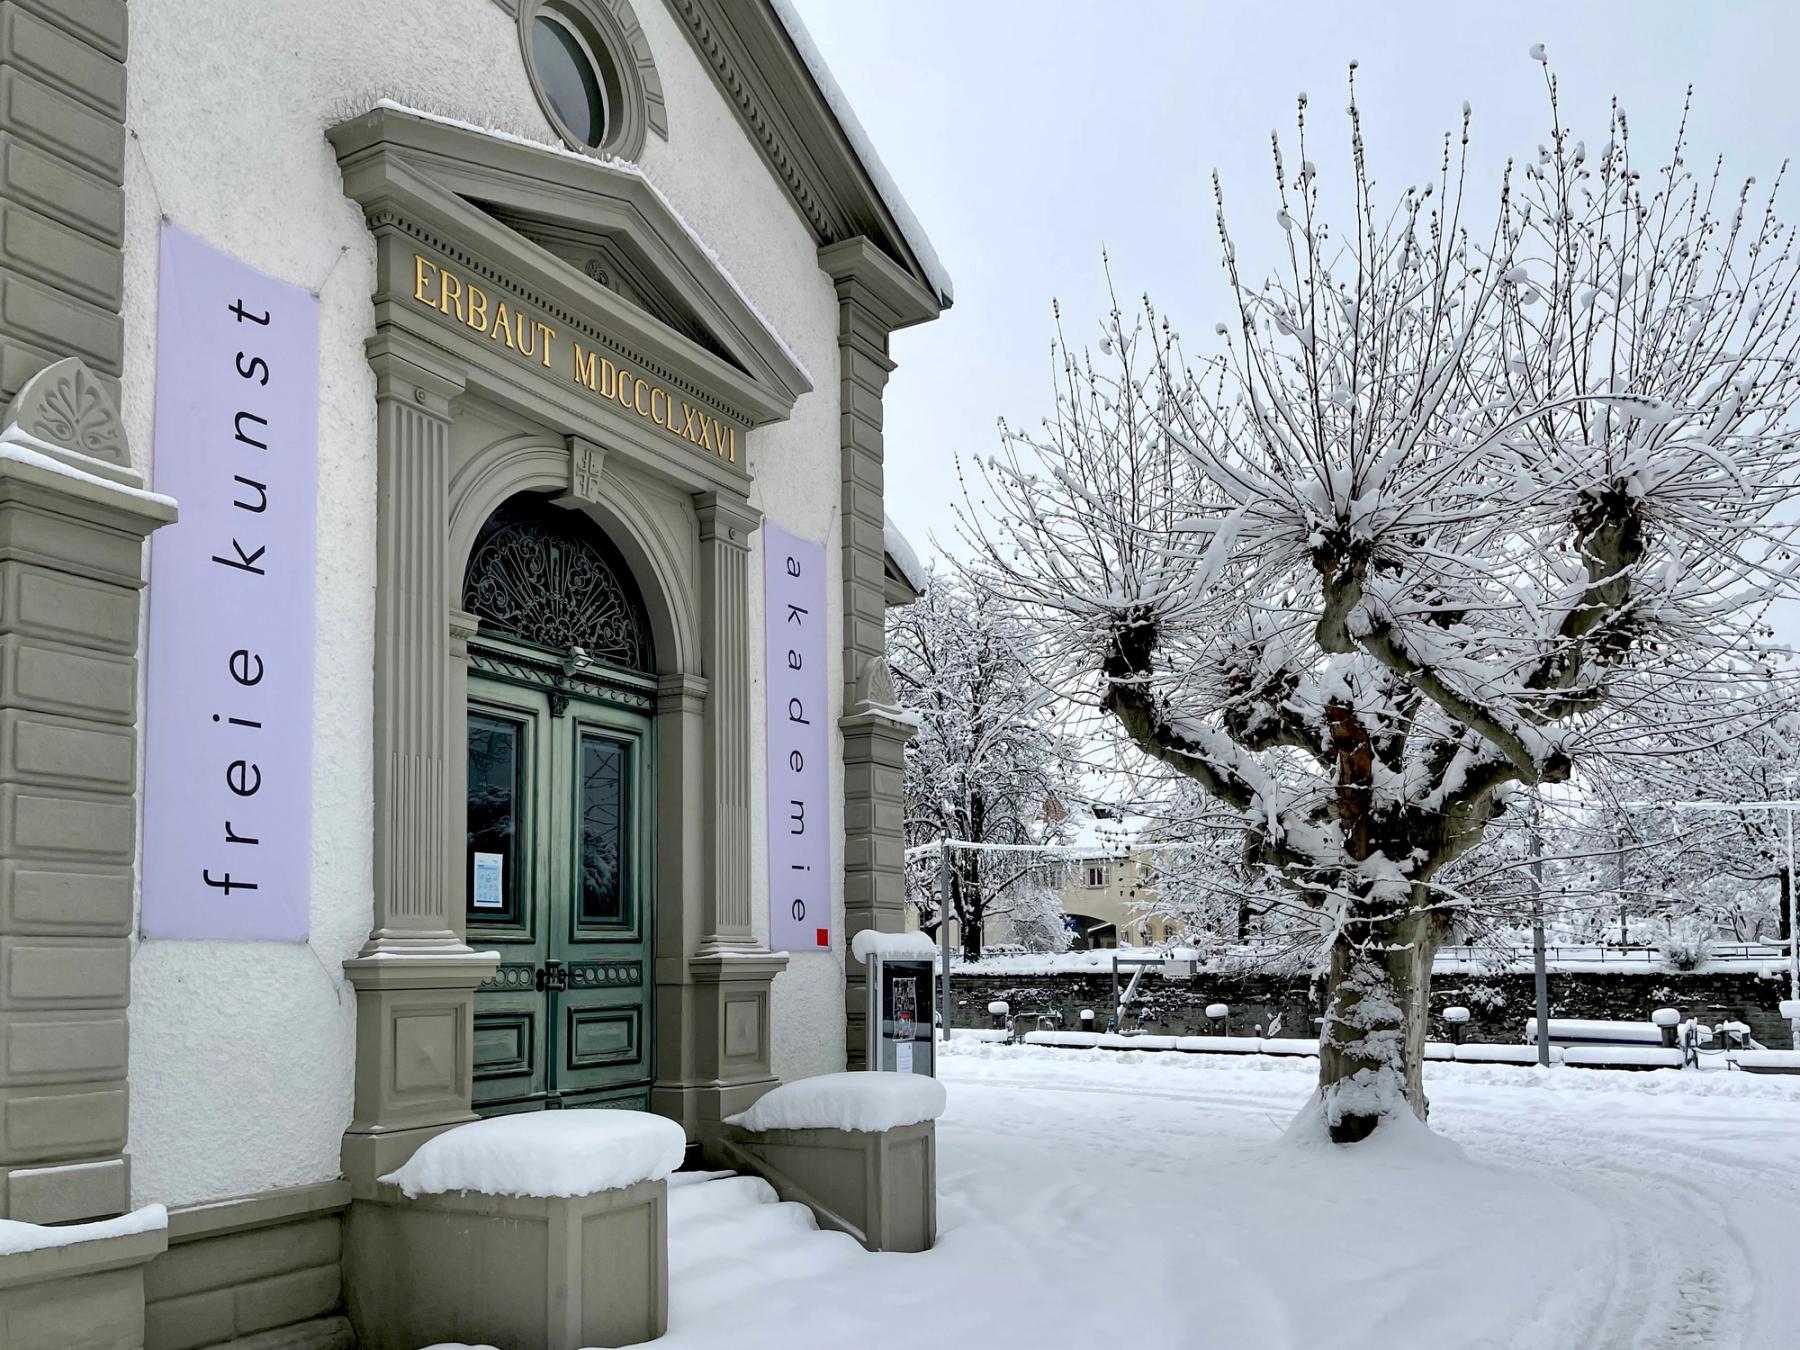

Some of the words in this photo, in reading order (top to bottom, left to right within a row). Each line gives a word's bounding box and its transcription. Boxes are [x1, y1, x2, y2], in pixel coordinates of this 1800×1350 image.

[211, 298, 271, 576] kunst
[414, 255, 556, 368] ERBAUT
[574, 342, 736, 463] MDCCCLXXVI
[202, 648, 264, 896] freie
[786, 555, 811, 922] akademie
